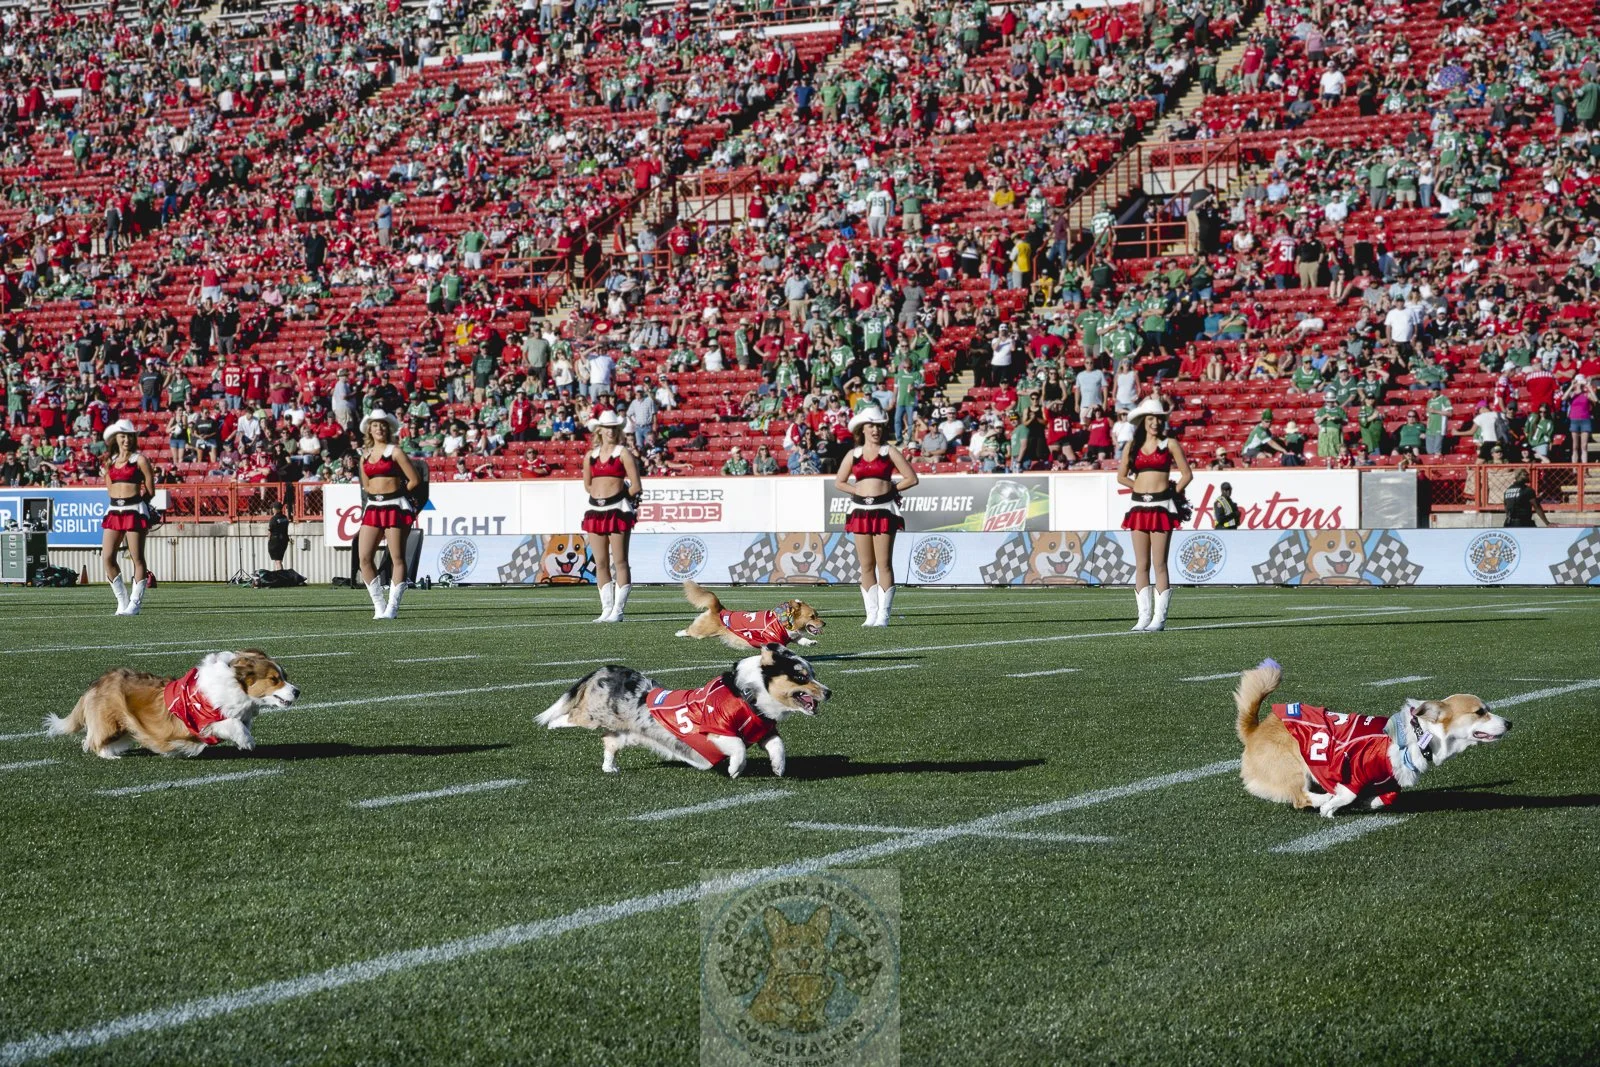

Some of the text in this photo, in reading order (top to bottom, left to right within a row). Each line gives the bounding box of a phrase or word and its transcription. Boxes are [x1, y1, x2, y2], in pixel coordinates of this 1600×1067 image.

[867, 322, 881, 333] 56
[1117, 340, 1127, 352] 4
[225, 374, 240, 387] 02
[253, 374, 259, 387] 1
[900, 496, 939, 512] CITRUS
[940, 495, 974, 511] TASTE
[661, 506, 719, 520] RIDE
[1180, 535, 1223, 552] SOUTHERN ALBERTA
[1470, 533, 1517, 550] SOUTHERN ALBERTA
[675, 707, 694, 734] 5
[1310, 731, 1330, 761] 2
